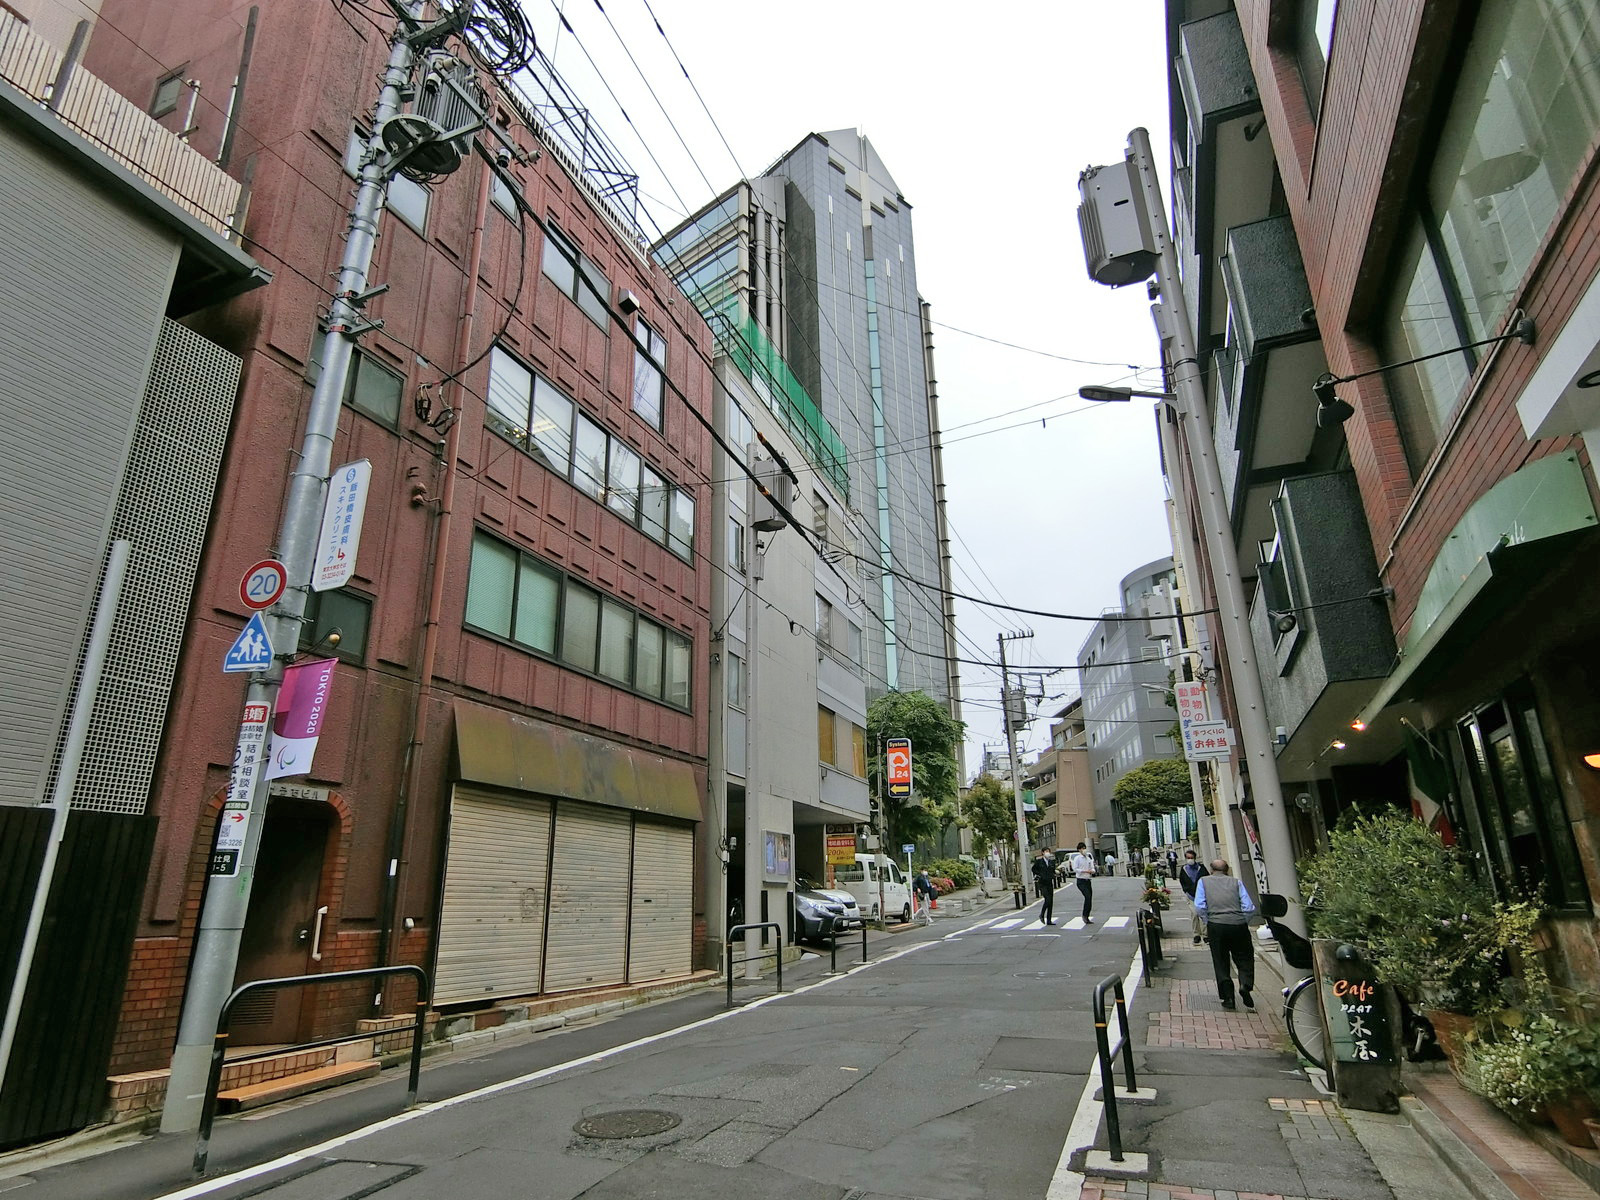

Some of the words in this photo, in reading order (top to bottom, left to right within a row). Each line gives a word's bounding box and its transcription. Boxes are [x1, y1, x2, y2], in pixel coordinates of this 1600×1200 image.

[327, 486, 346, 565] スキンクリニック
[250, 574, 277, 596] 20
[314, 668, 331, 704] TOKYO
[306, 706, 321, 734] 2020
[1193, 728, 1225, 737] 手づくりの
[1194, 738, 1228, 749] お弁当
[237, 744, 257, 799] 結婚相談室
[896, 770, 908, 778] 24
[1333, 979, 1374, 1001] Cafe
